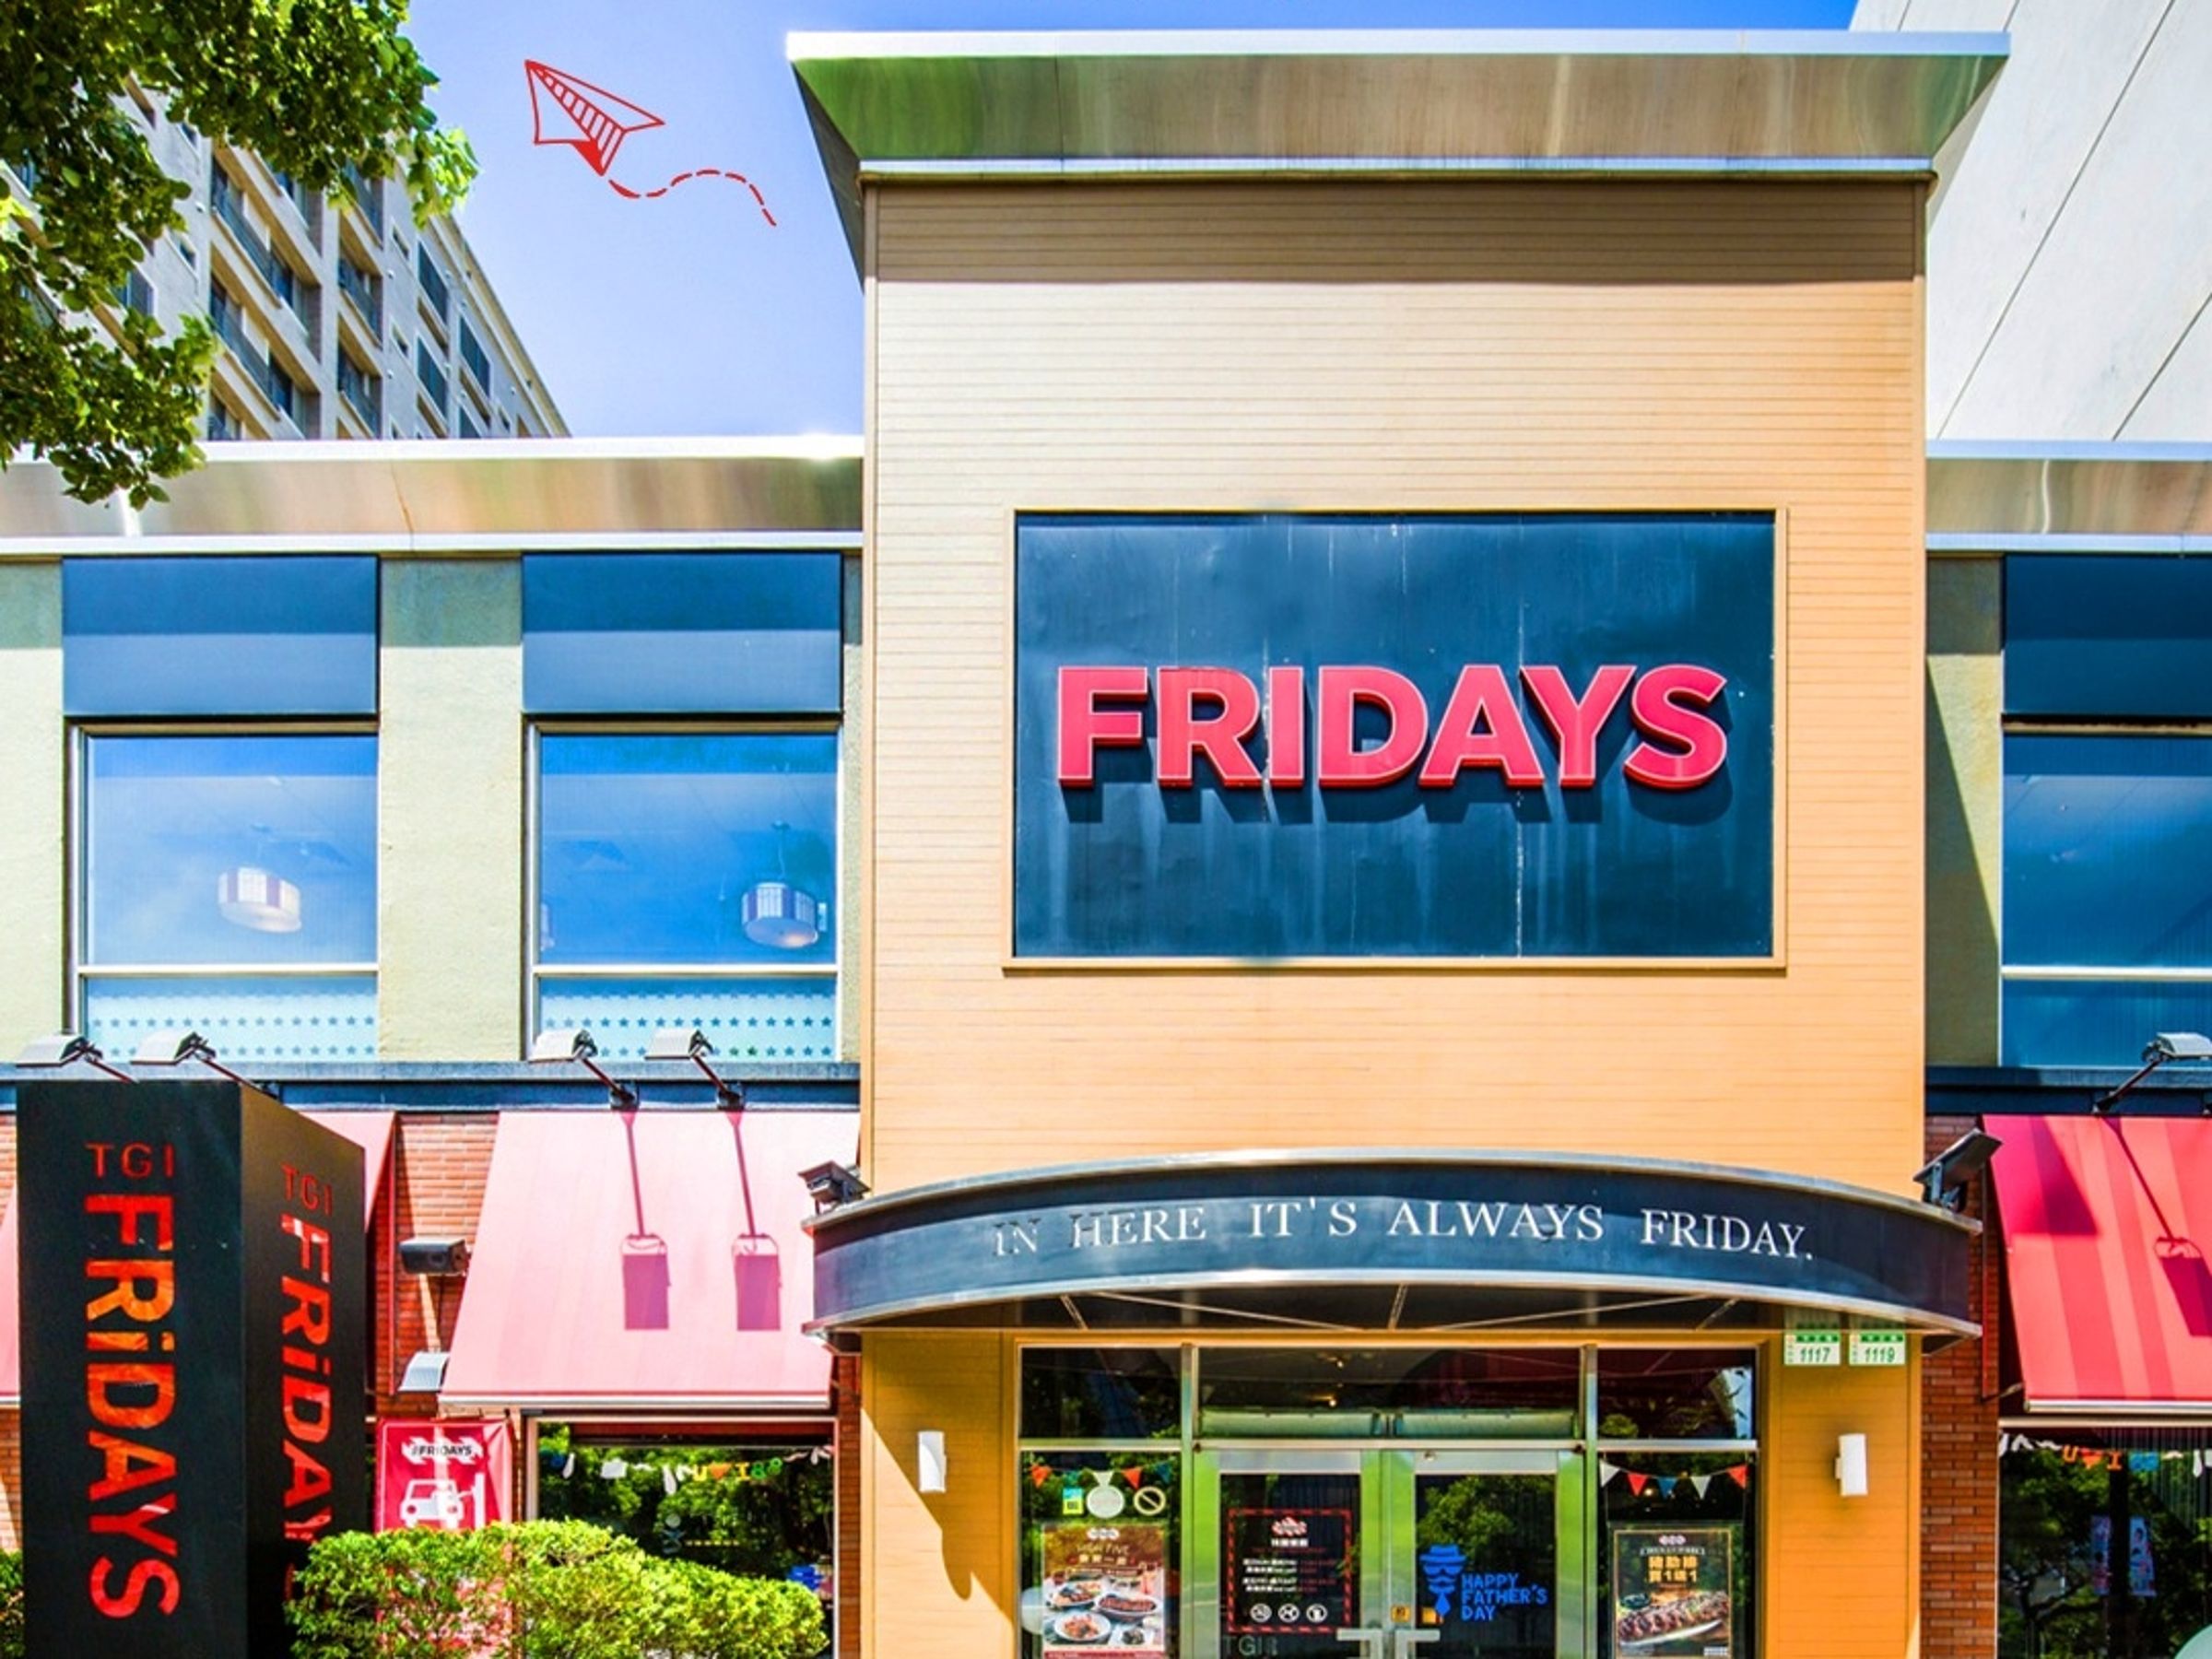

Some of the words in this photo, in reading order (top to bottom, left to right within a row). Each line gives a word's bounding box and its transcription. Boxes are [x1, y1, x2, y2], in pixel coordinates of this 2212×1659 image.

[1057, 664, 1728, 790] FRIDAYS
[85, 1142, 175, 1179] TGI
[279, 1164, 333, 1216] TGI
[993, 1218, 1041, 1257] IN
[1069, 1206, 1207, 1250] HERE
[1250, 1198, 1358, 1239] IT'S
[1385, 1201, 1604, 1242] ALWAYS
[1639, 1207, 1814, 1260] FRIDAY.
[1799, 1347, 1830, 1363] 1117
[1865, 1347, 1896, 1363] 1119
[1462, 1573, 1519, 1590] HAPPY
[1462, 1583, 1548, 1606] FATHER'S
[1462, 1605, 1496, 1622] DAY
